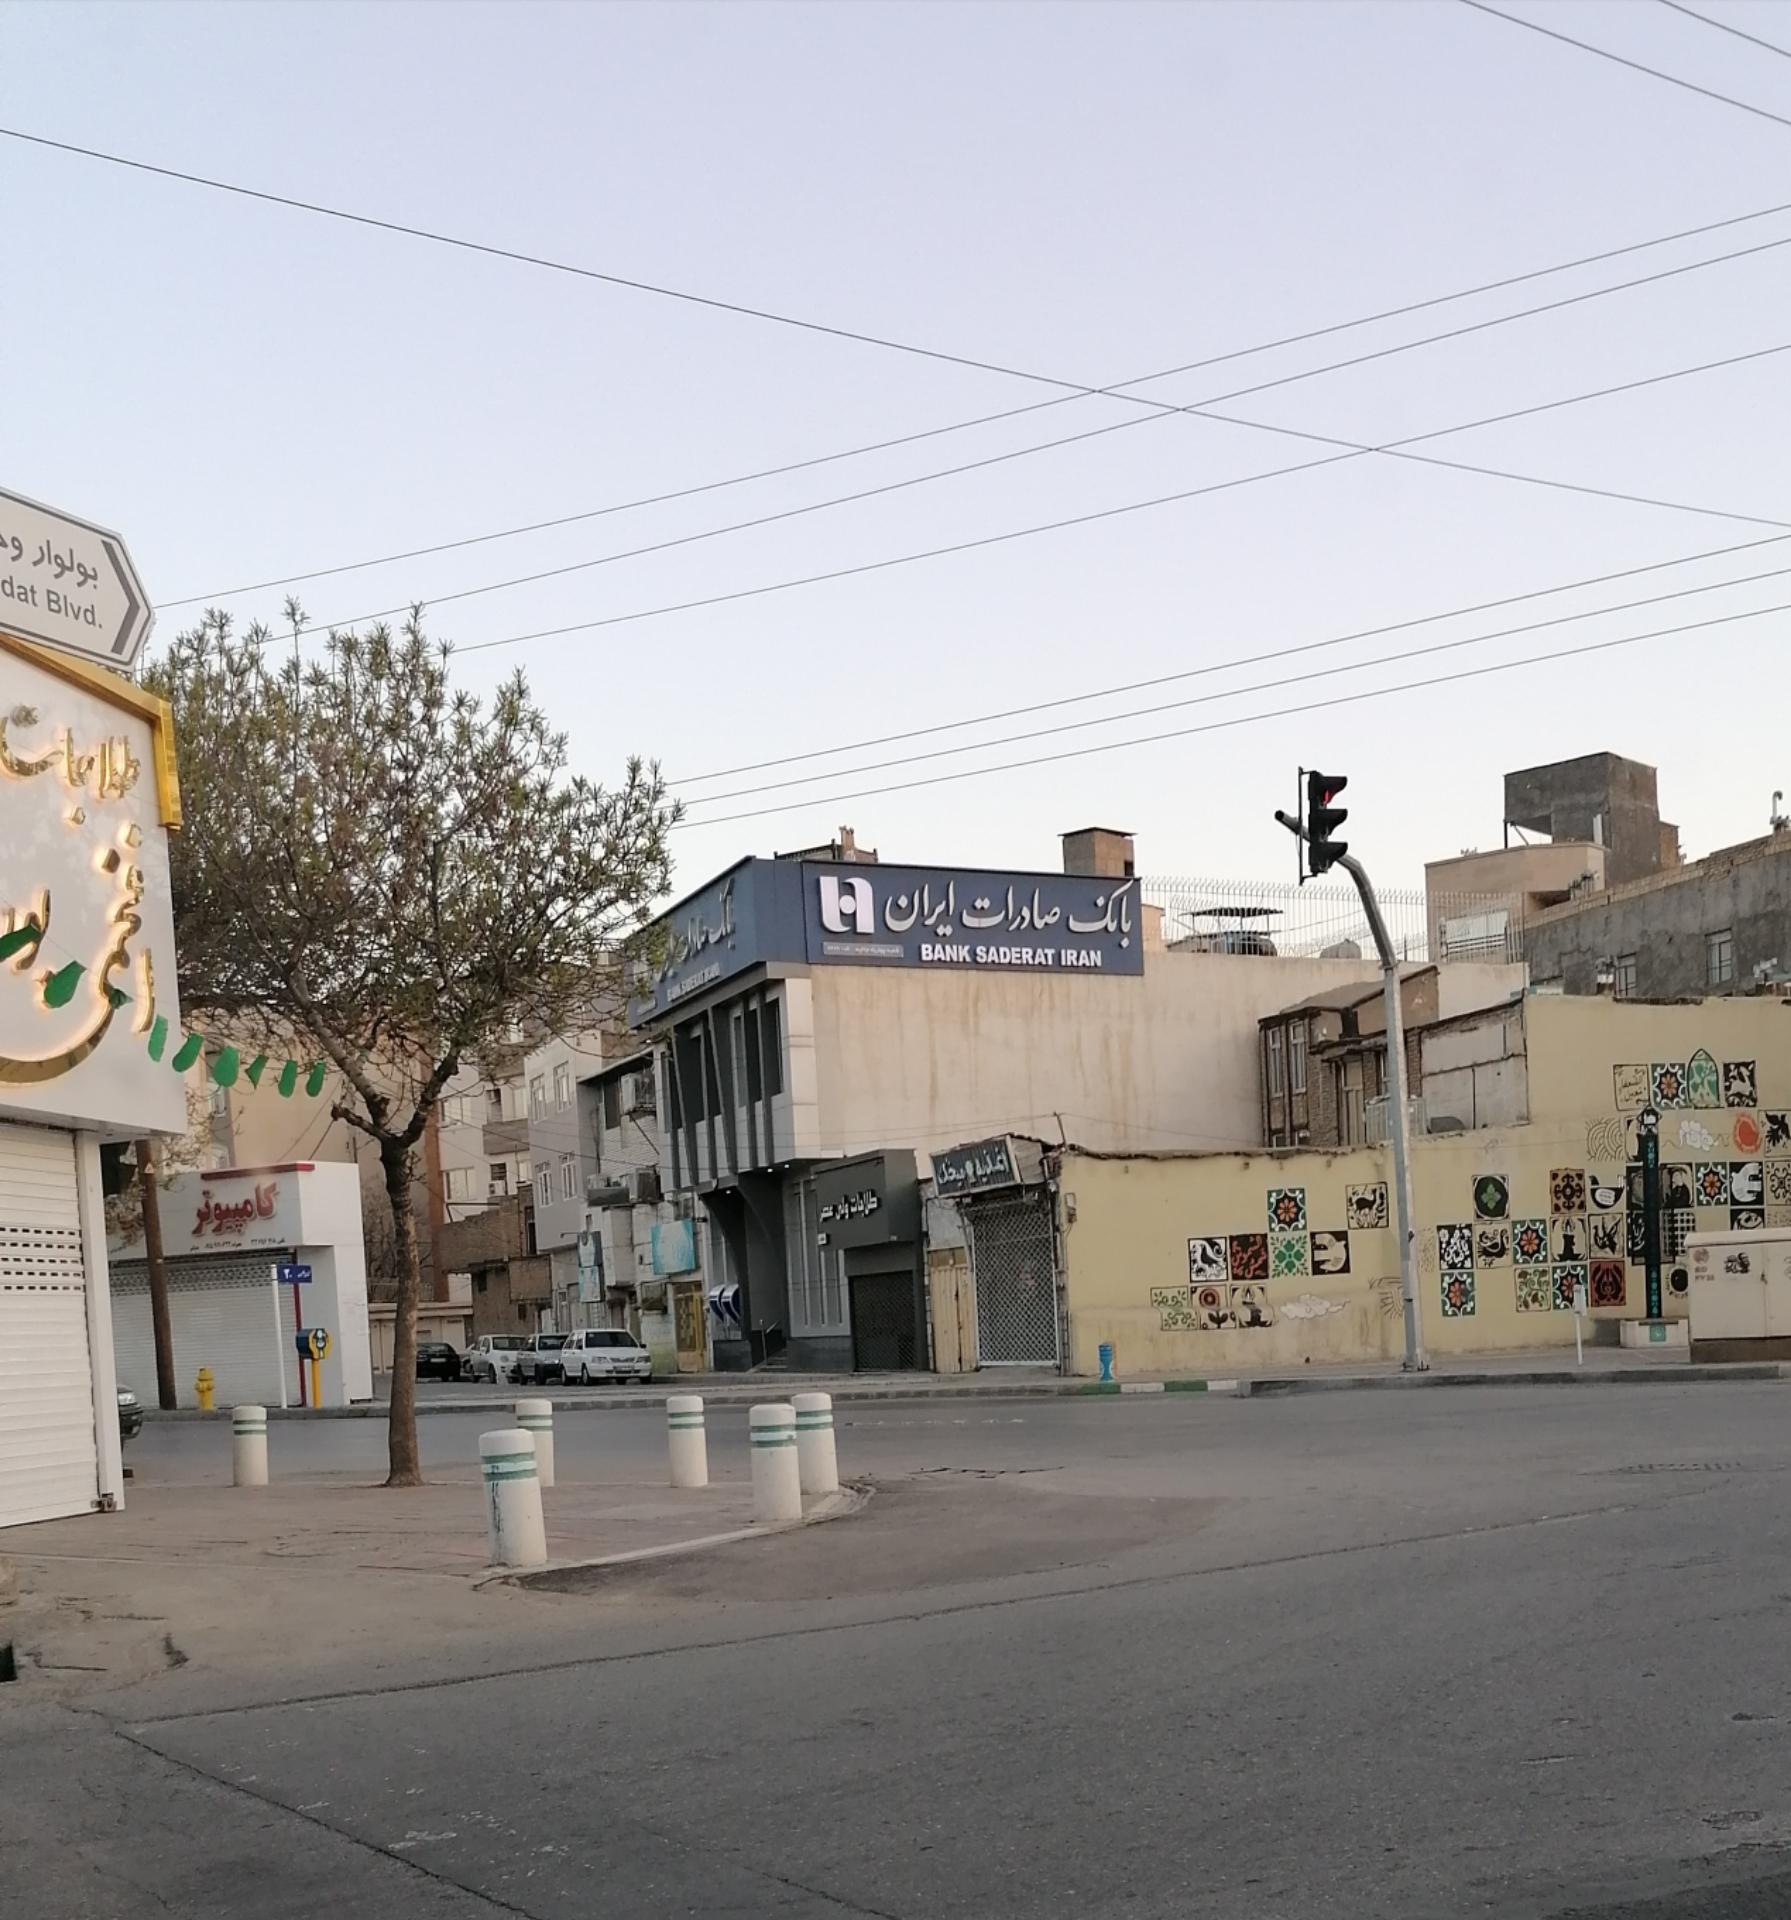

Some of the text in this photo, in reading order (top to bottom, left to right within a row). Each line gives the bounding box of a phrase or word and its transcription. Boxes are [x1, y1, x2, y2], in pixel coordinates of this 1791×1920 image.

[32, 539, 98, 589] بولوار
[46, 589, 103, 629] Blvd.
[885, 879, 1134, 949] بانک صادرات ایران
[921, 943, 971, 963] BANK
[976, 945, 1055, 966] SADERAT
[1060, 949, 1102, 967] IRAN
[192, 1182, 279, 1235] کامپیوتر
